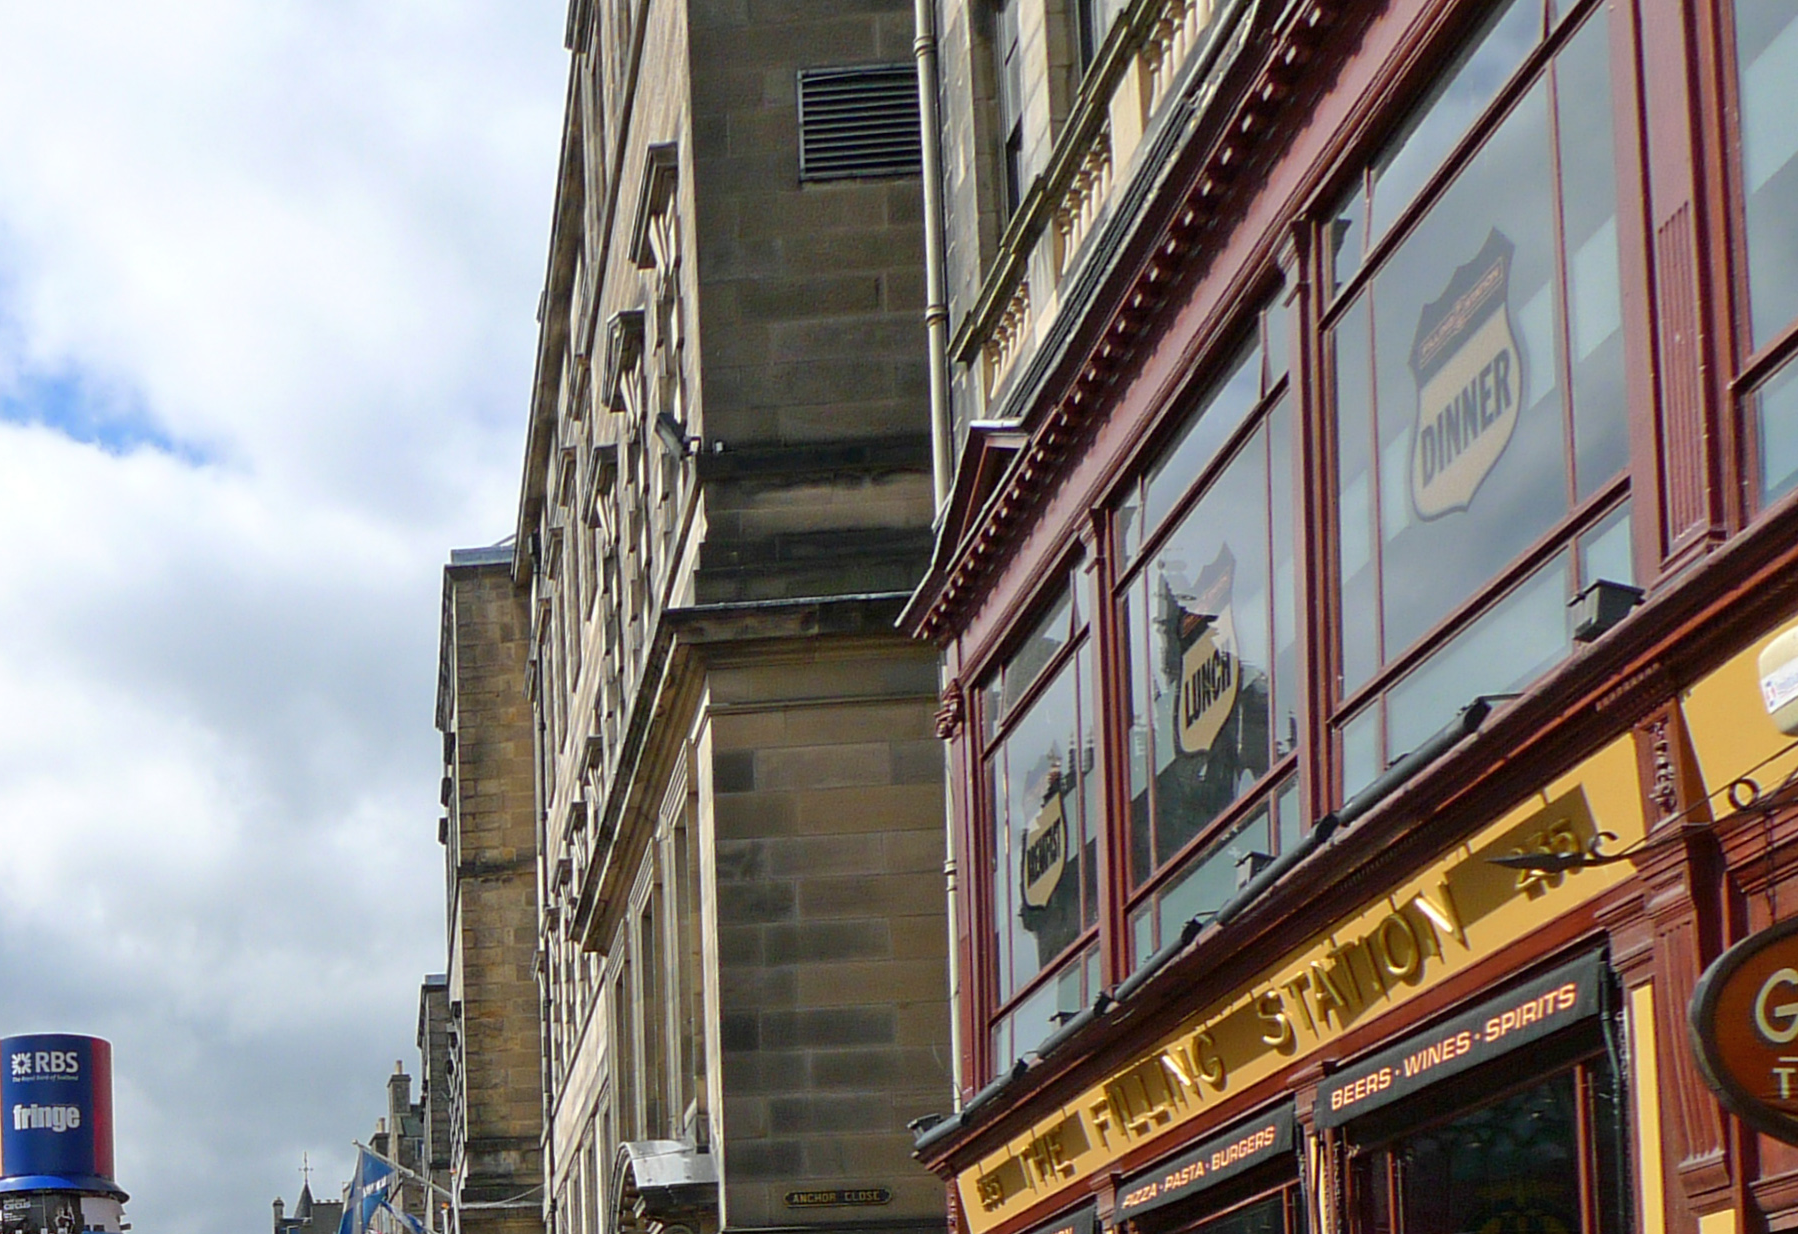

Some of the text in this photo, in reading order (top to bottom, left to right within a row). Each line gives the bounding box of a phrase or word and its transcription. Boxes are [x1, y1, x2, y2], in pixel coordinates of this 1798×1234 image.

[1421, 347, 1512, 489] DINNER
[1185, 638, 1231, 730] LUNCH
[35, 1051, 79, 1073] RBS
[1020, 1124, 1075, 1187] THE
[1089, 1032, 1223, 1145] FILLING
[1257, 880, 1468, 1046] STATION
[1332, 982, 1577, 1111] BEERS WINES SPIRITS
[13, 1103, 80, 1132] fringe
[793, 1191, 880, 1204] ANCHOR CLOSE
[1122, 1125, 1276, 1209] PIZZA PASTA BURGERS
